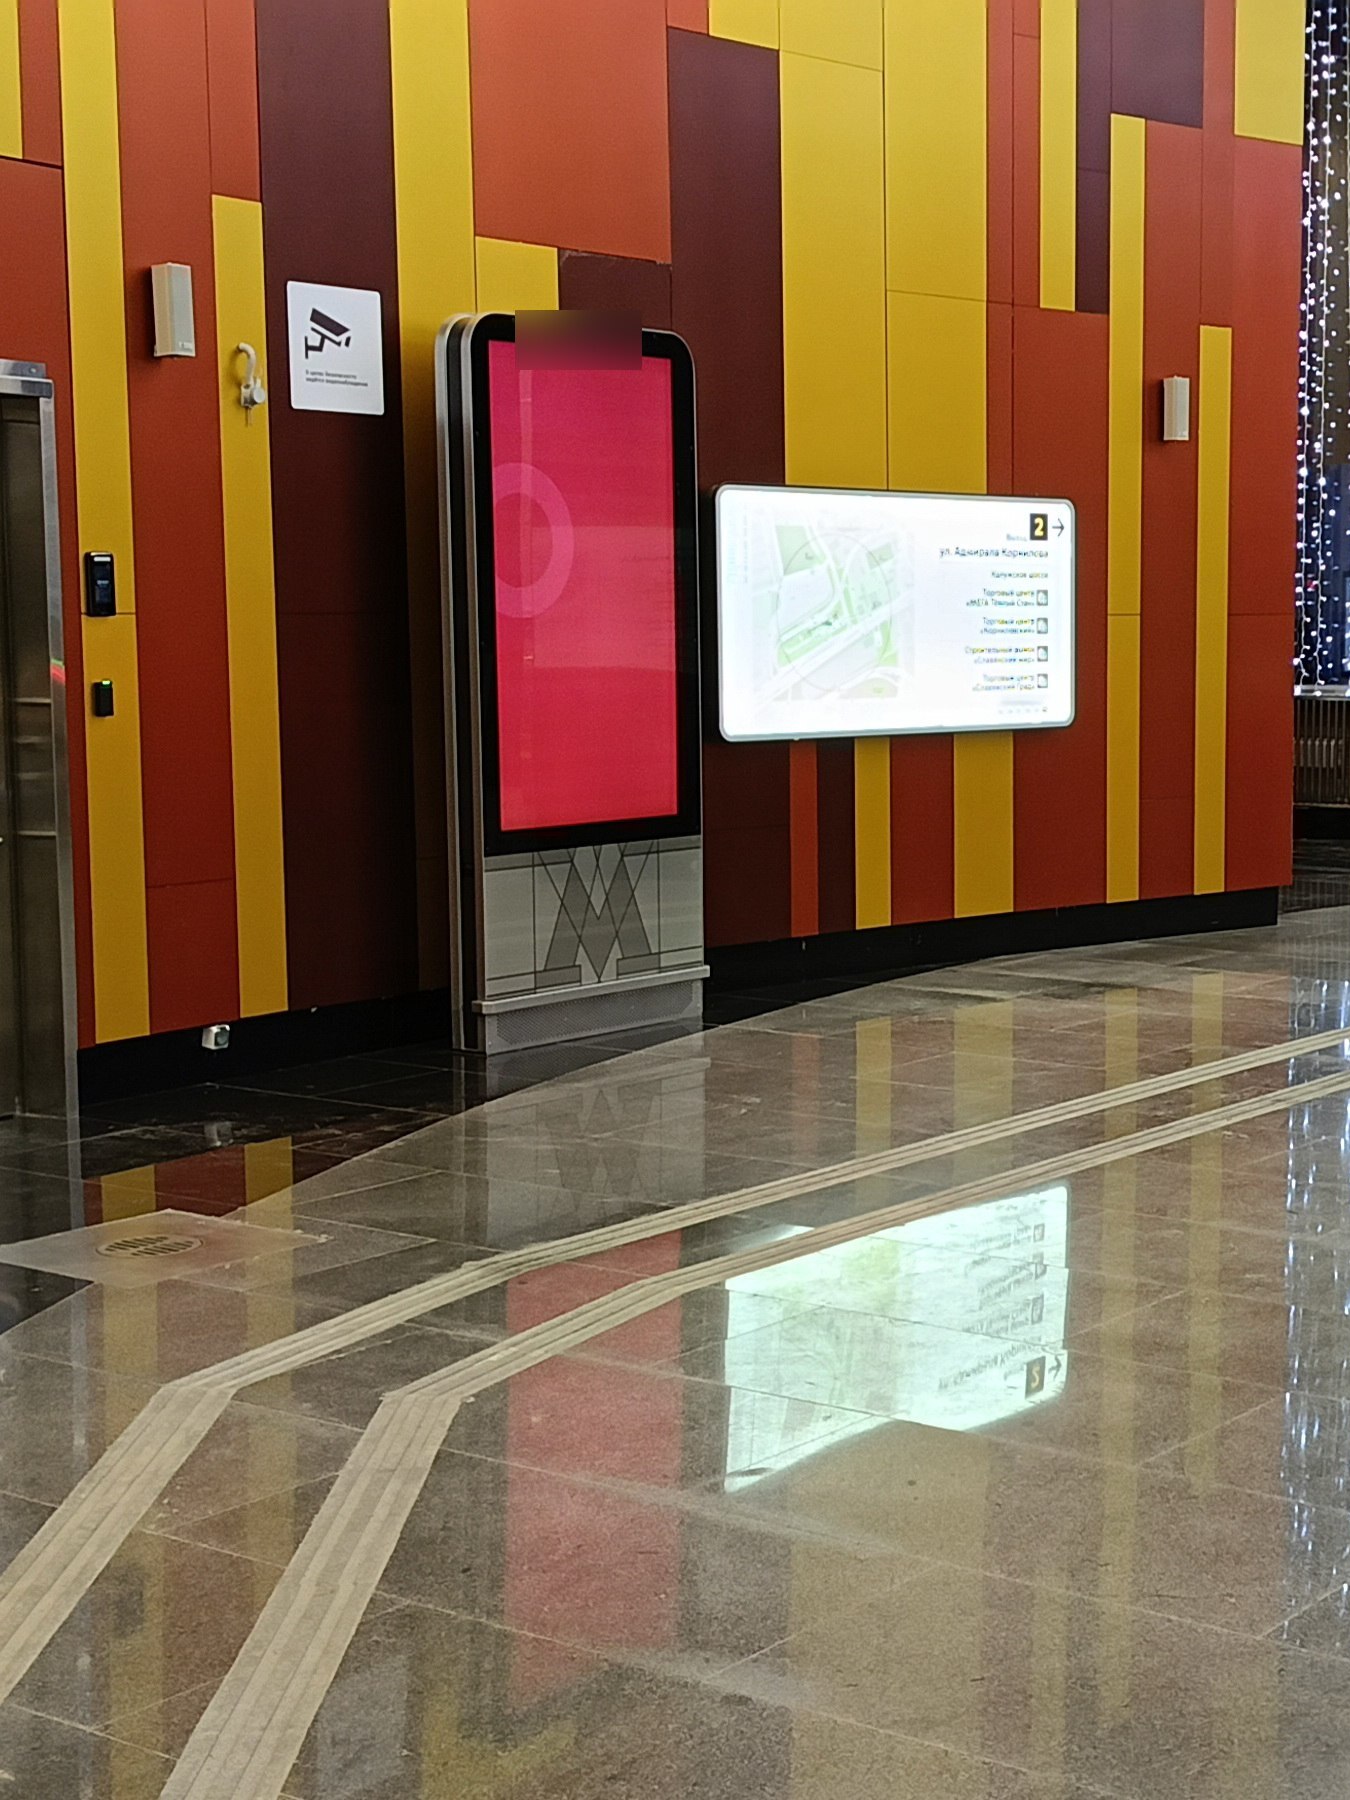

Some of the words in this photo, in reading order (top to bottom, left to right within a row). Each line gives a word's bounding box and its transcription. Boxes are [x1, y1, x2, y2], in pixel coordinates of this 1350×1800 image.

[1034, 517, 1044, 536] 2
[954, 546, 1000, 558] Адмирала
[1001, 547, 1049, 559] Корнилова
